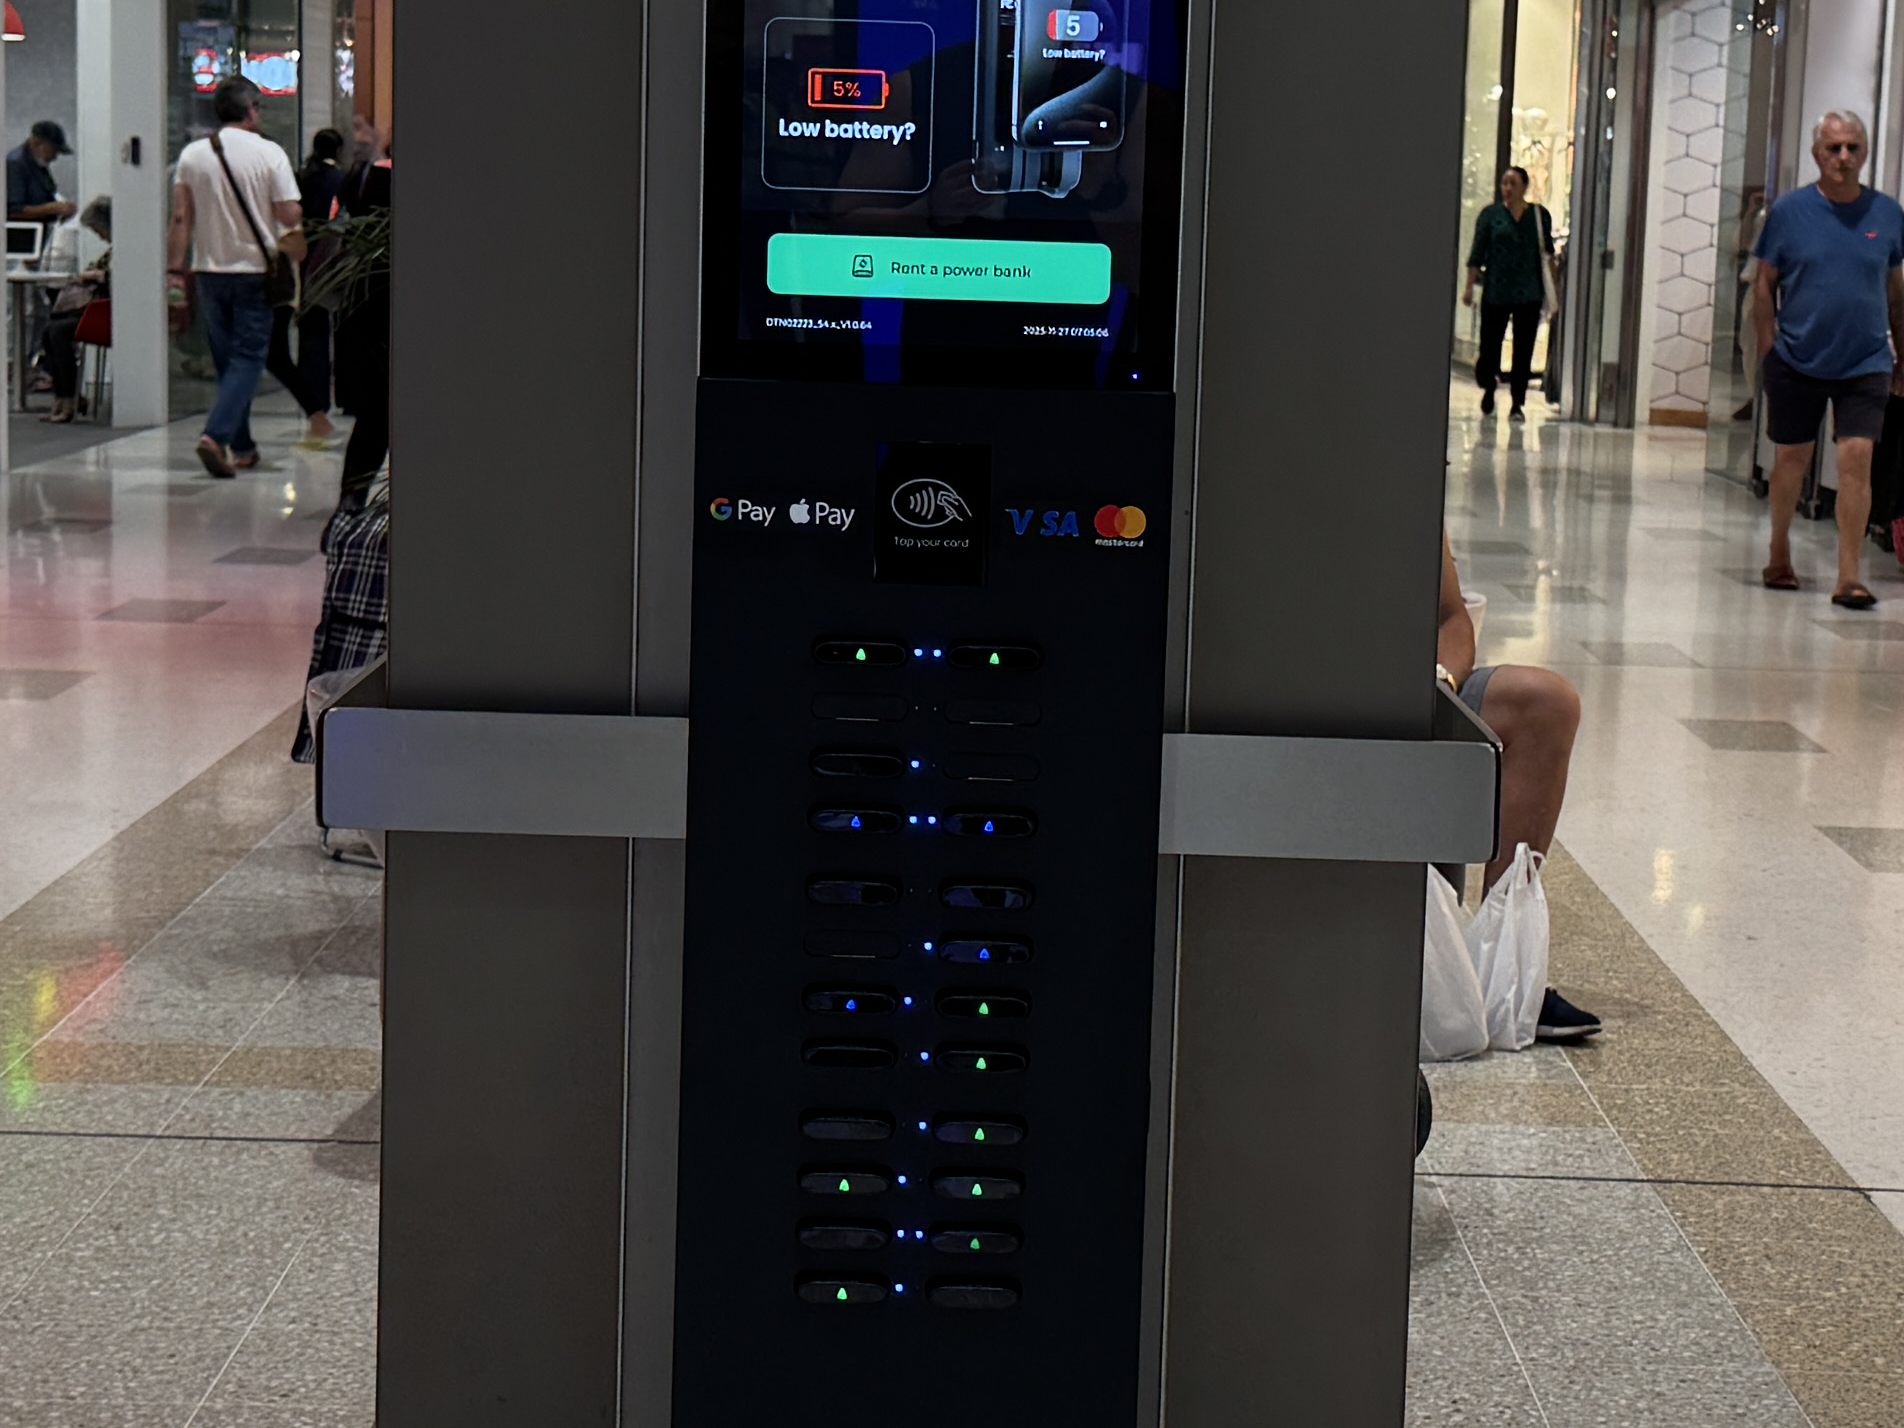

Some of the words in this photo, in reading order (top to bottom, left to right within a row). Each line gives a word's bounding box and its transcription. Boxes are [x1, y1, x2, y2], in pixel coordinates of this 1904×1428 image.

[1066, 15, 1081, 36] 5
[833, 80, 862, 97] 5%
[779, 118, 821, 137] Low
[825, 119, 917, 146] battery?
[891, 261, 926, 276] Rent
[930, 265, 939, 275] a
[943, 265, 989, 278] power
[993, 264, 1032, 278] bank
[709, 497, 733, 522] G
[737, 499, 776, 529] Pay
[815, 501, 856, 532] Pay
[1004, 508, 1080, 538] VSA
[894, 535, 916, 548] Tap
[916, 538, 941, 549] your
[944, 538, 970, 548] card
